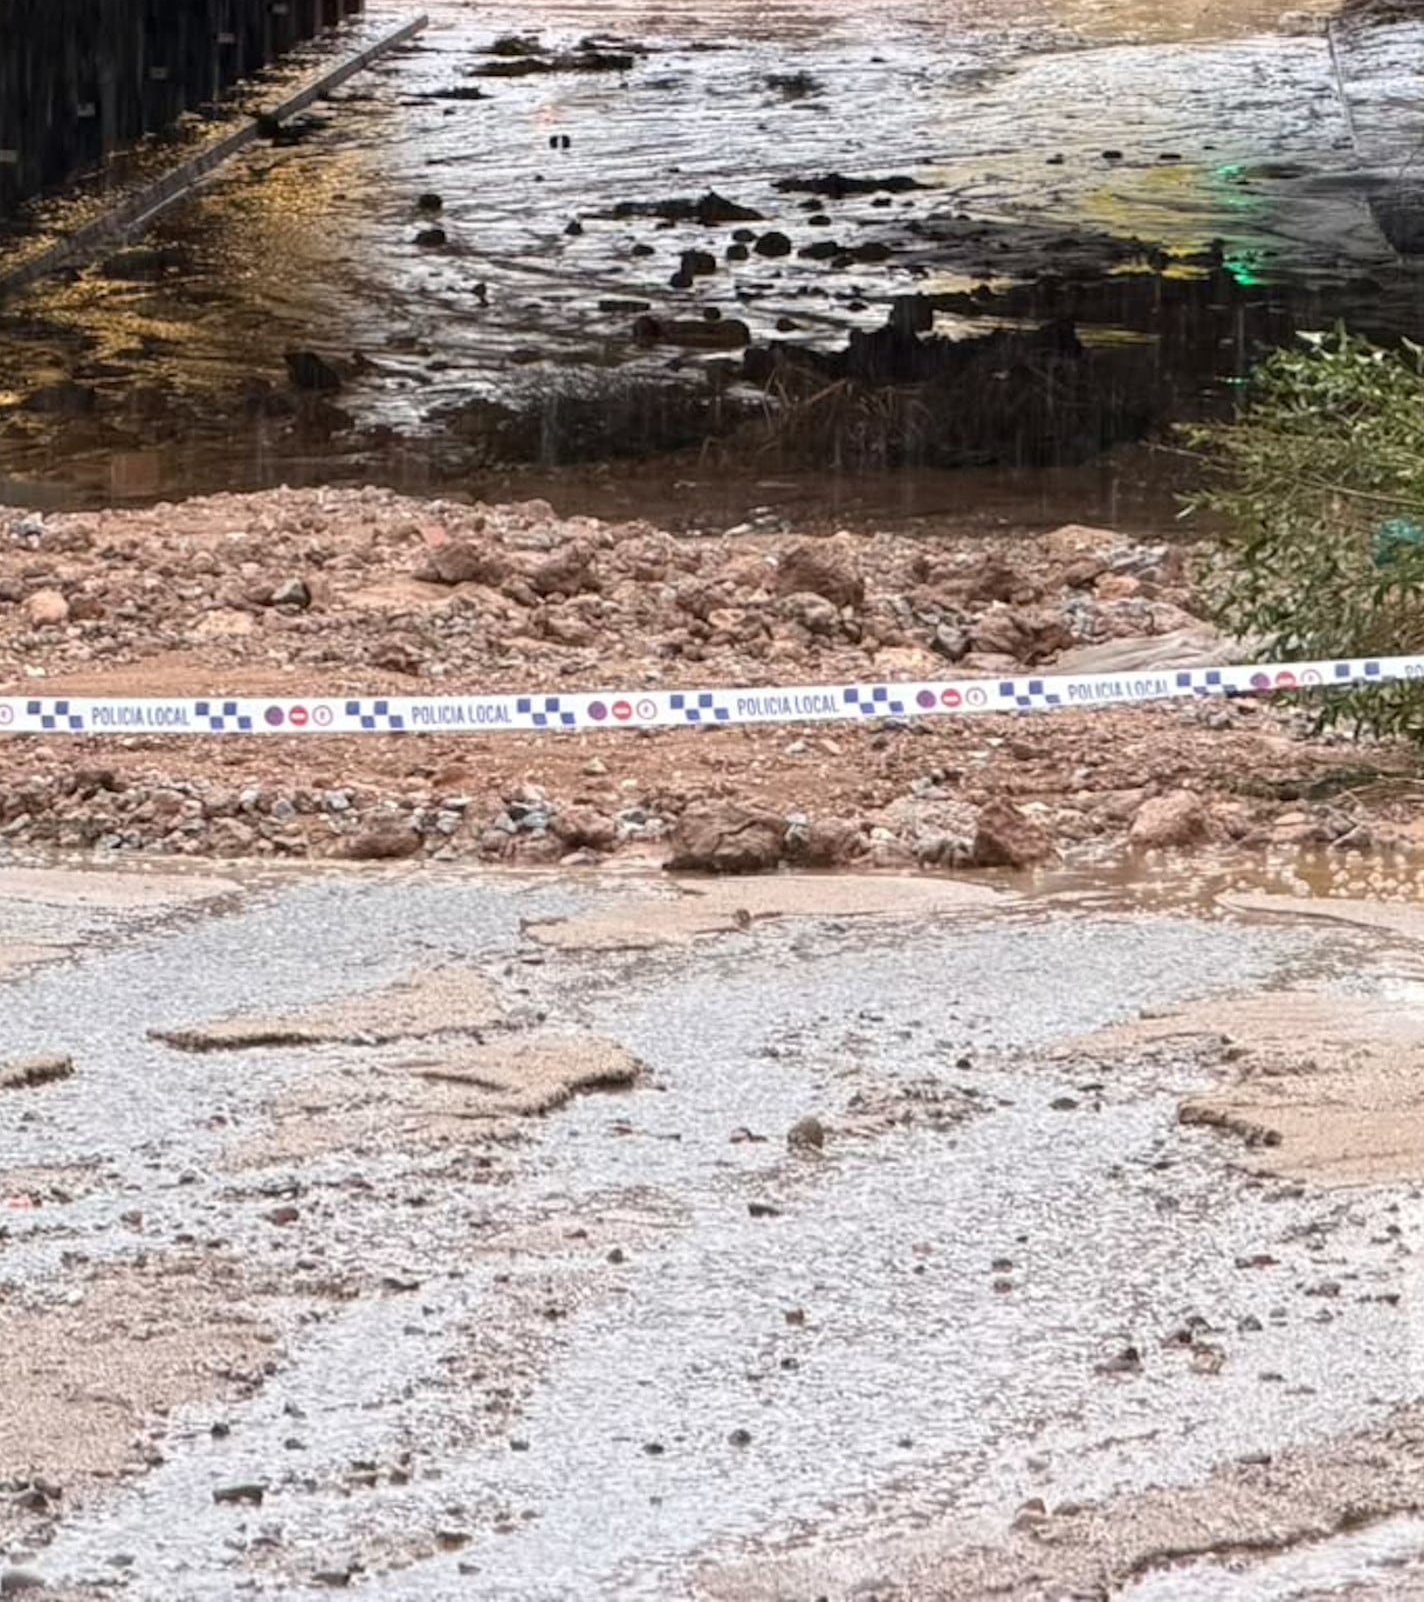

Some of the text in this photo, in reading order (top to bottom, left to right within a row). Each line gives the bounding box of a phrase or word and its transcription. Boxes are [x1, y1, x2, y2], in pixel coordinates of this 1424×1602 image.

[1068, 681, 1124, 701] POLICIA
[411, 704, 512, 725] POLICIA LOCAL
[737, 694, 840, 717] POLICIA LOCAL
[92, 706, 191, 727] POLICIA LOCAL
